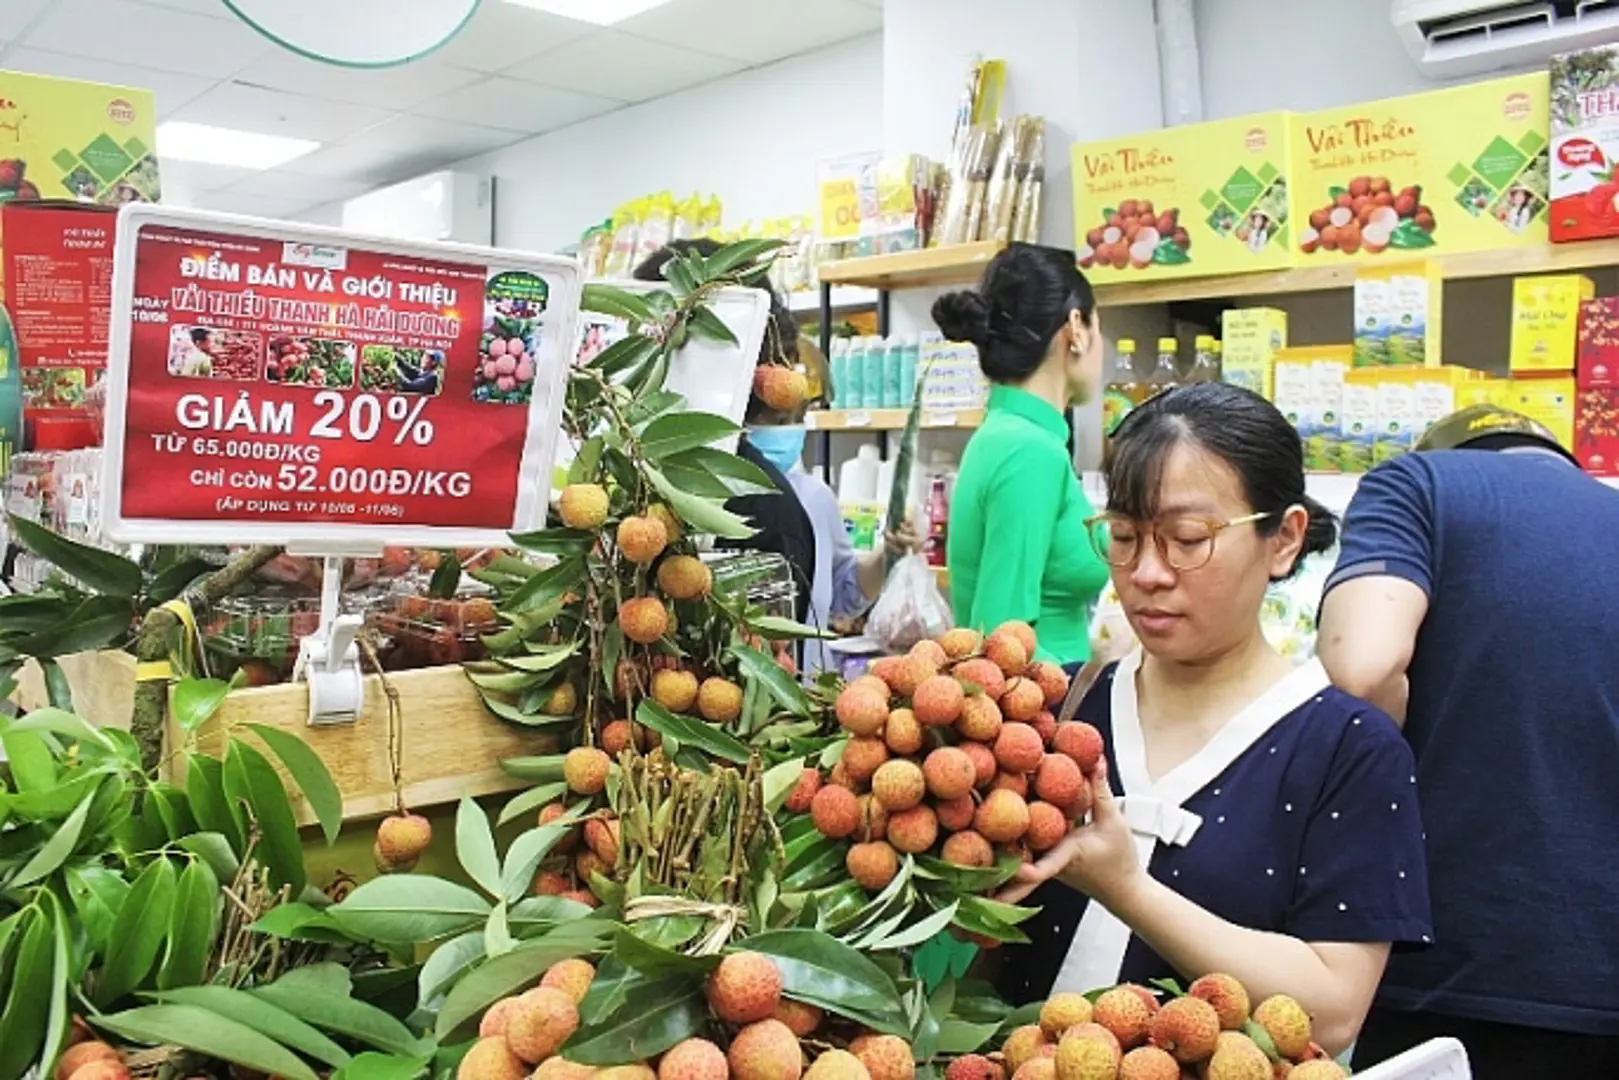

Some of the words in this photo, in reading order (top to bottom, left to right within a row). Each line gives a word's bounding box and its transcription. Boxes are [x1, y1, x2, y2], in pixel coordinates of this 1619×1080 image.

[180, 251, 240, 281] ĐIỂM
[247, 262, 296, 288] BÁN
[302, 263, 334, 292] VÀ
[342, 275, 391, 299] GIỚI
[398, 281, 457, 309] THIỆU
[268, 297, 331, 325] THANH
[333, 301, 361, 329] HÀ
[397, 310, 460, 338] DƯƠNG
[176, 389, 295, 434] GIẢM
[310, 391, 434, 445] 20%
[151, 431, 187, 453] TỪ
[192, 437, 321, 463] 65.000Đ/KG
[190, 468, 225, 487] CHỈ
[230, 470, 272, 489] CÒN
[277, 463, 471, 497] 52.000Đ/KG
[216, 495, 244, 512] (ÁP
[246, 500, 290, 513] DỤNG
